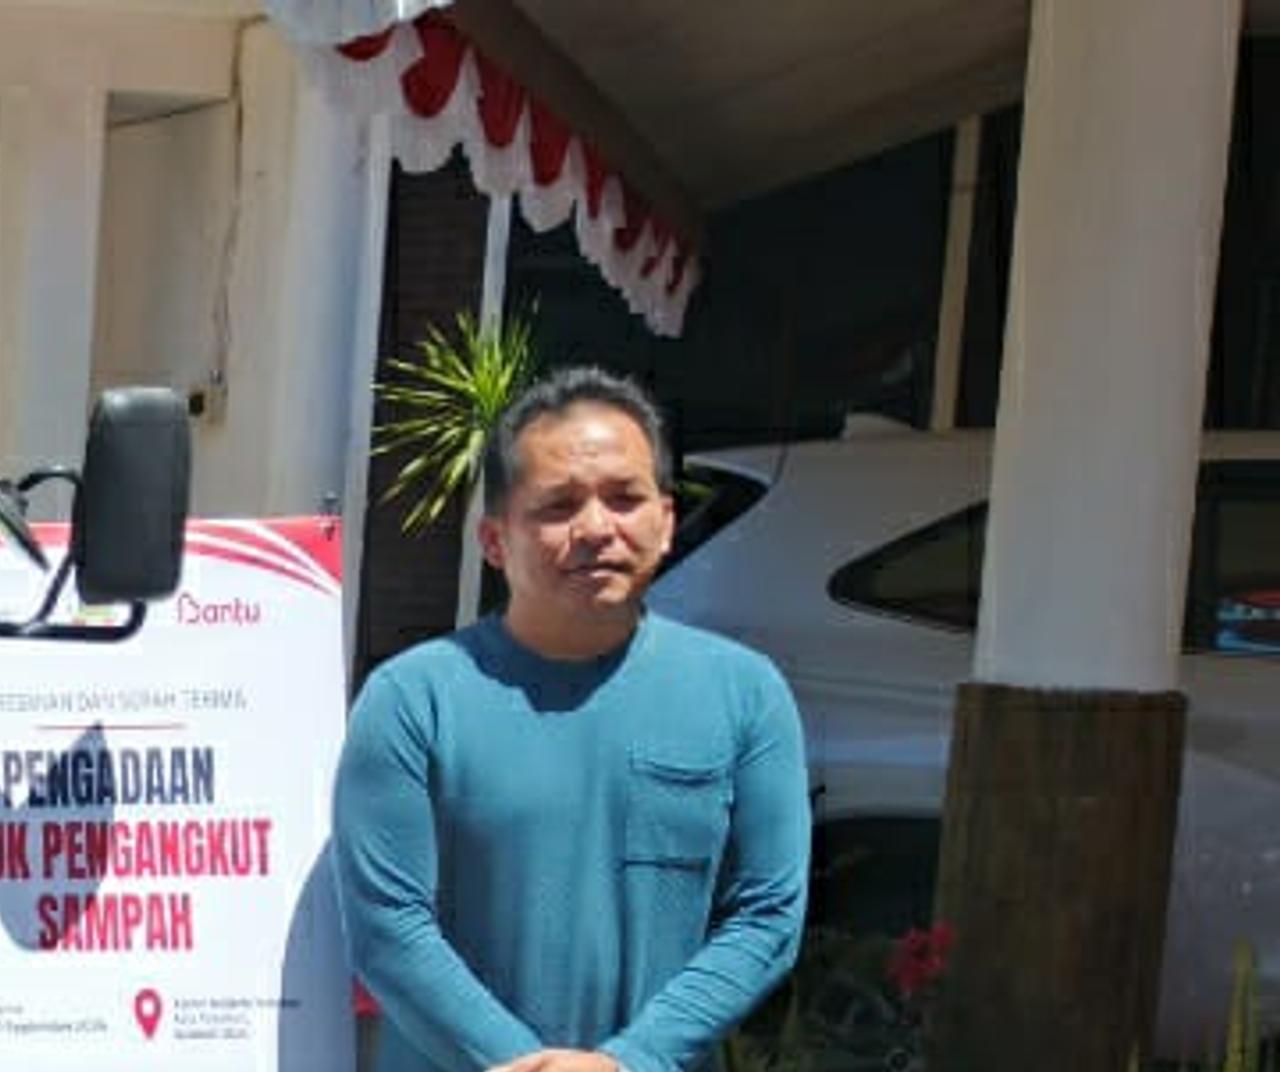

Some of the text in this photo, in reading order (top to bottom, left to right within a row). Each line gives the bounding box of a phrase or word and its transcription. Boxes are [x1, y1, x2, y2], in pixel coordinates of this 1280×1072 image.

[176, 594, 262, 625] Bantu
[2, 747, 216, 808] PENGADAAN
[42, 819, 273, 880] PENGANGKUT
[39, 893, 194, 953] SAMPAH
